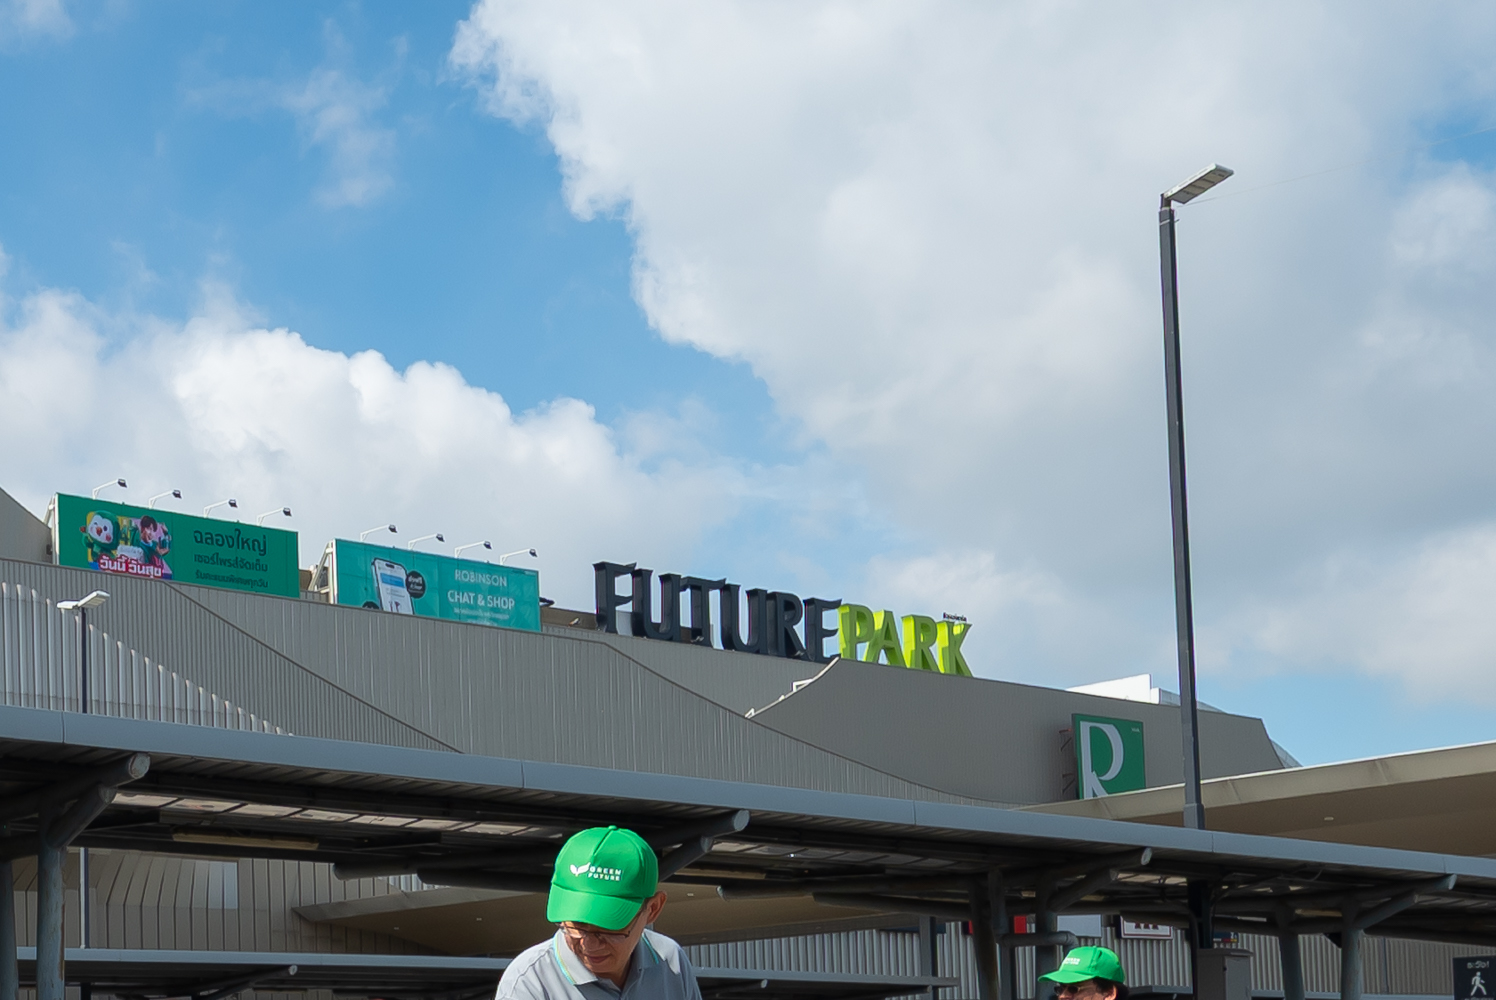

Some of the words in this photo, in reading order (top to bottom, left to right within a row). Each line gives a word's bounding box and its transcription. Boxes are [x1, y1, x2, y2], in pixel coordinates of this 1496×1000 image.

[193, 528, 267, 556] ฉลองใหญ่
[455, 569, 508, 587] ROBINSON
[447, 590, 475, 605] CHAT
[477, 594, 485, 606] &
[487, 595, 515, 610] SHOP
[587, 872, 621, 881] FUTURE
[589, 866, 622, 875] GREEN
